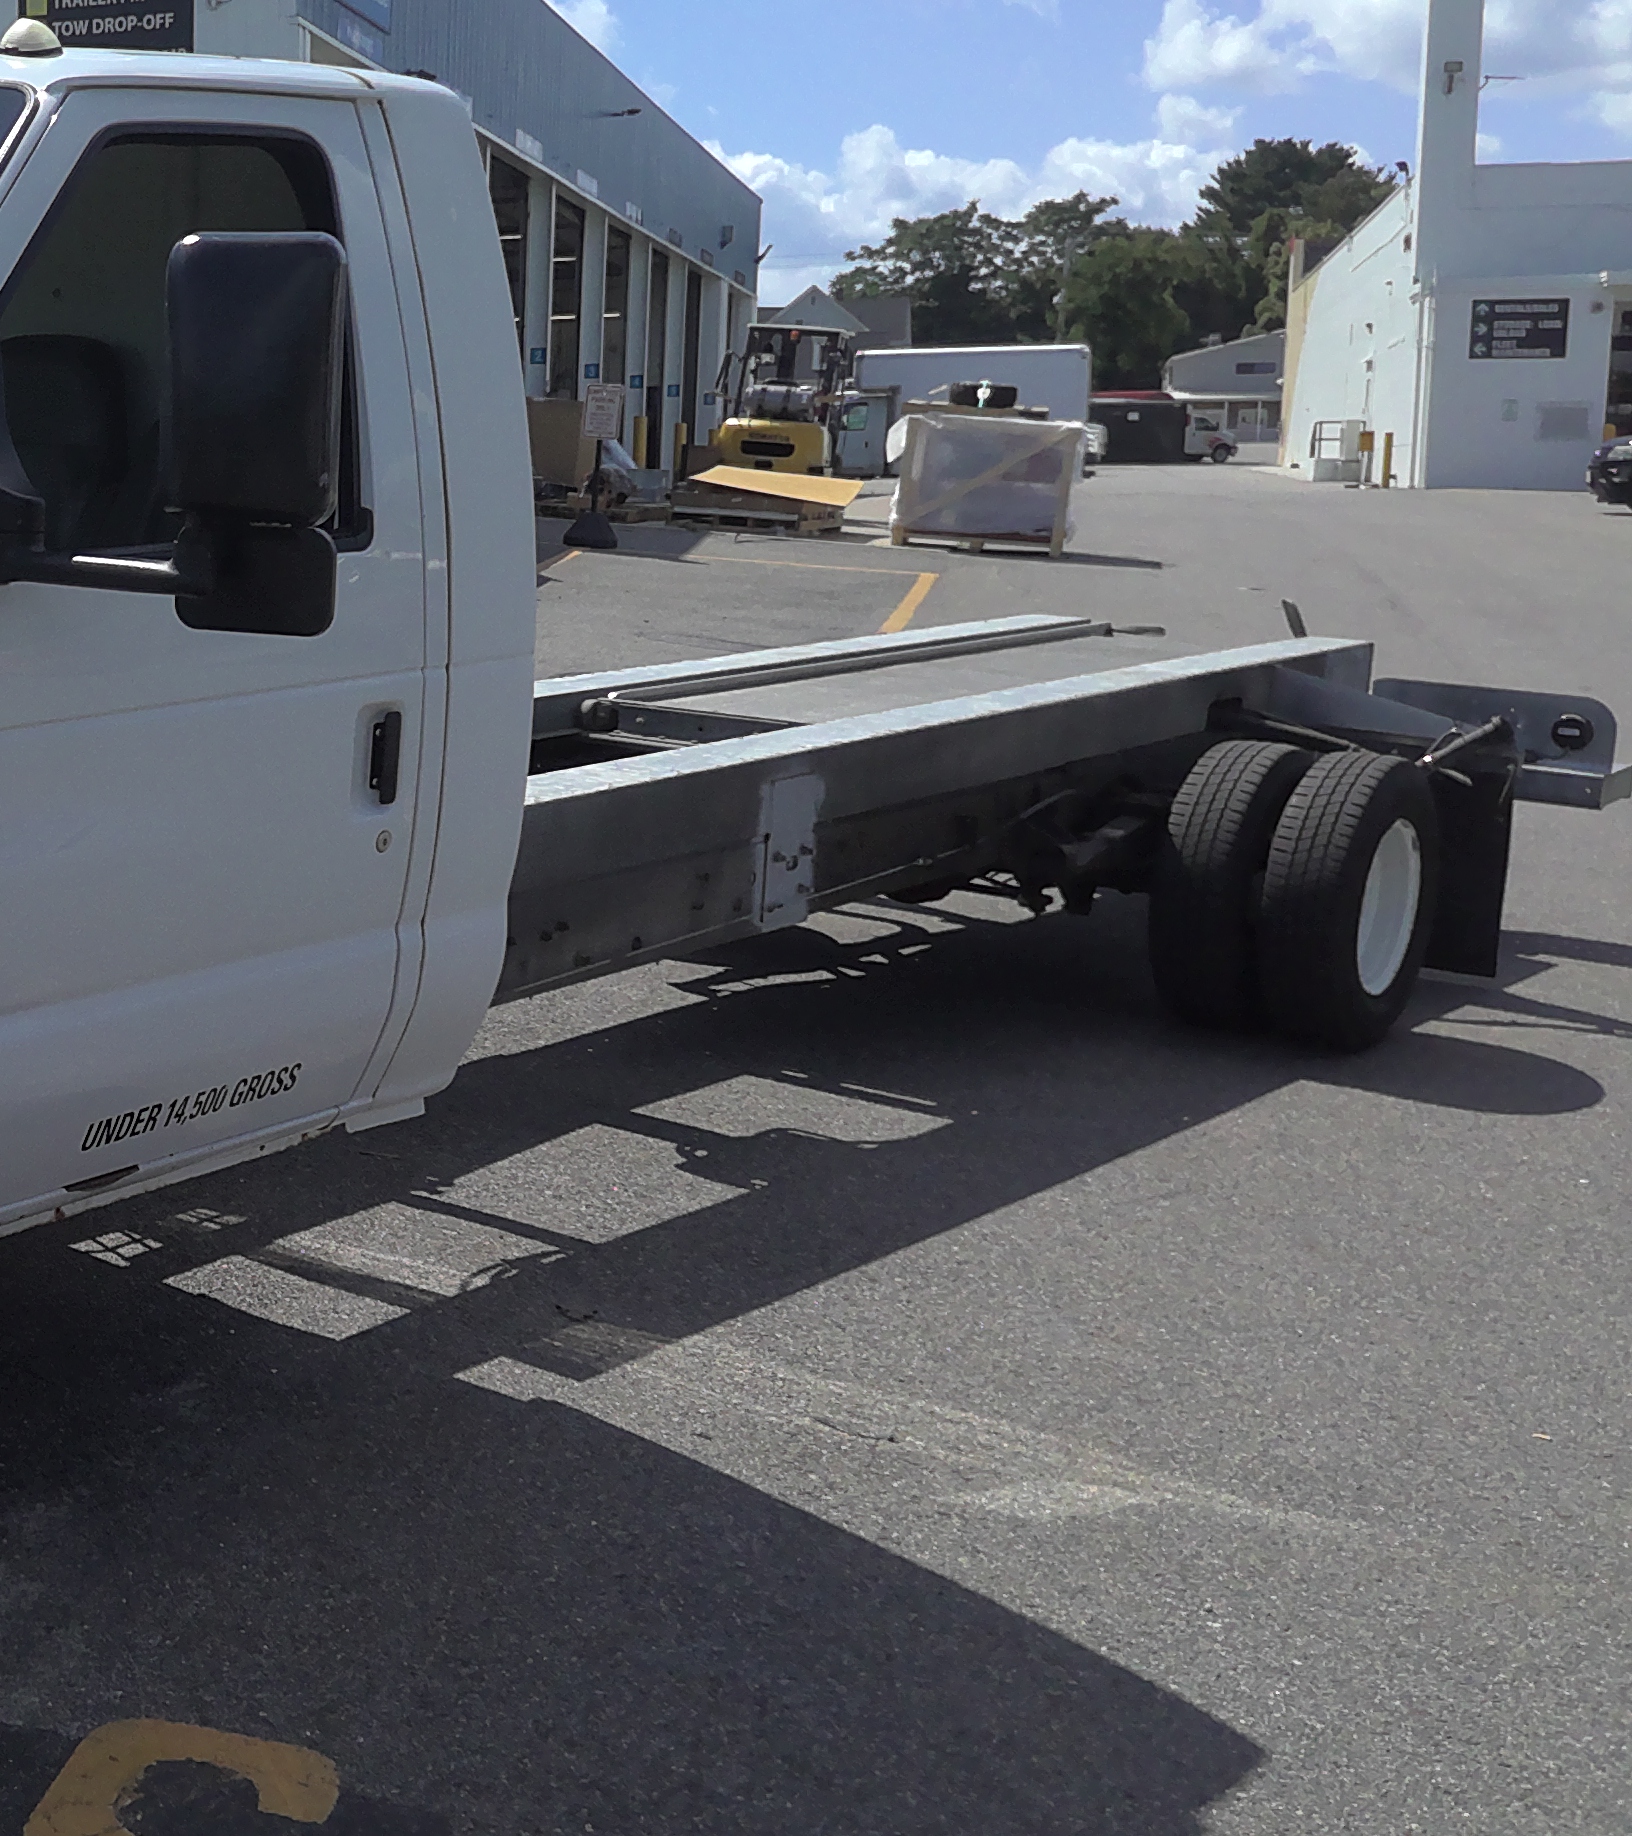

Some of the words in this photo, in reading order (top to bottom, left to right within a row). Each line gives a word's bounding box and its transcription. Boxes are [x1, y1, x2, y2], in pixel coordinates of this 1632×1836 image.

[52, 20, 89, 37] TOW
[92, 13, 174, 34] DROP-OFF
[81, 1103, 163, 1151] UNDER
[163, 1084, 228, 1127] 14,500
[229, 1062, 302, 1108] GROSS
